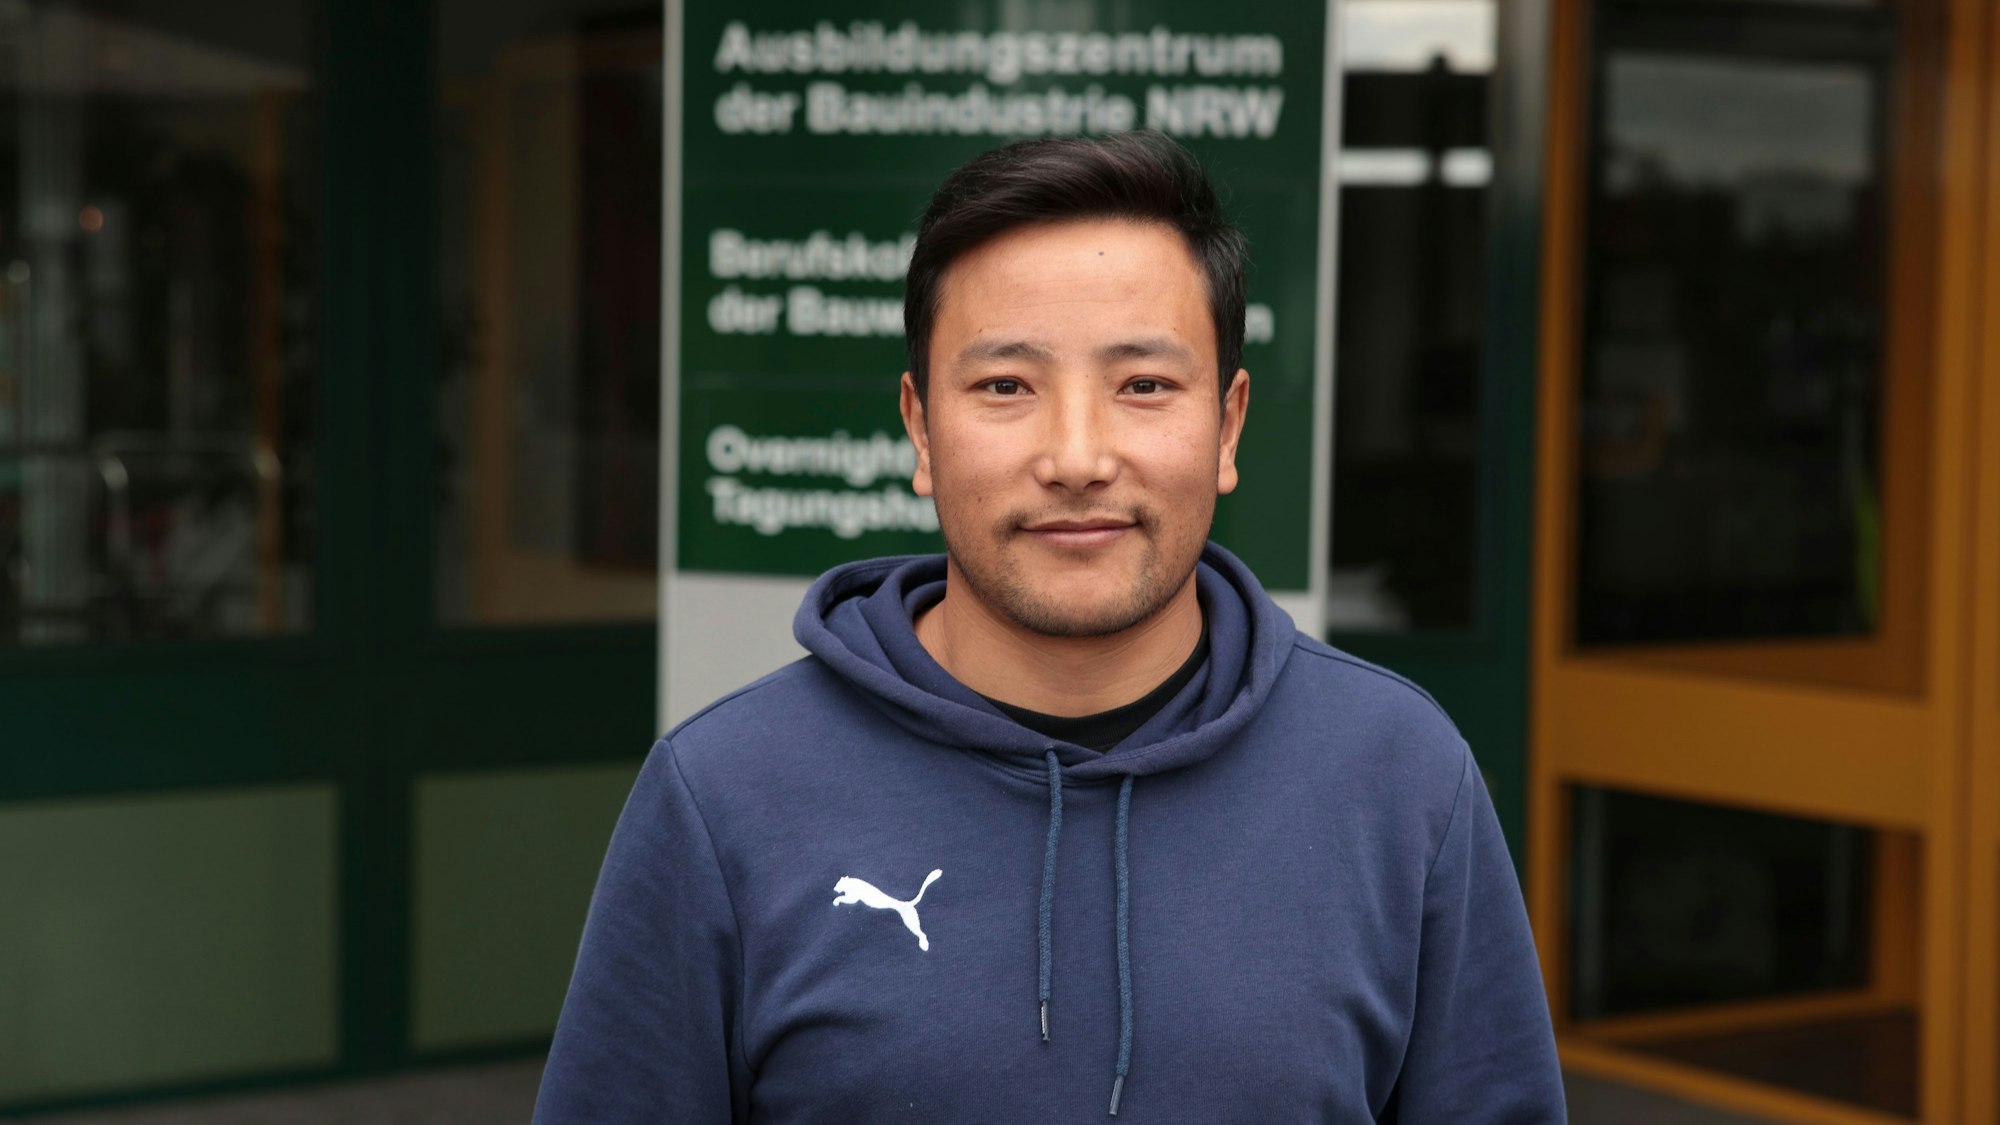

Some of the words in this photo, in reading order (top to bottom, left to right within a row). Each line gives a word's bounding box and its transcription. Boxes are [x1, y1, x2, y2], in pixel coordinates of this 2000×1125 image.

[715, 22, 1282, 82] Ausbildungszentrum
[715, 84, 797, 133] der
[807, 84, 1135, 136] Bauindustrie
[1147, 86, 1284, 137] NRW
[708, 288, 782, 332] der
